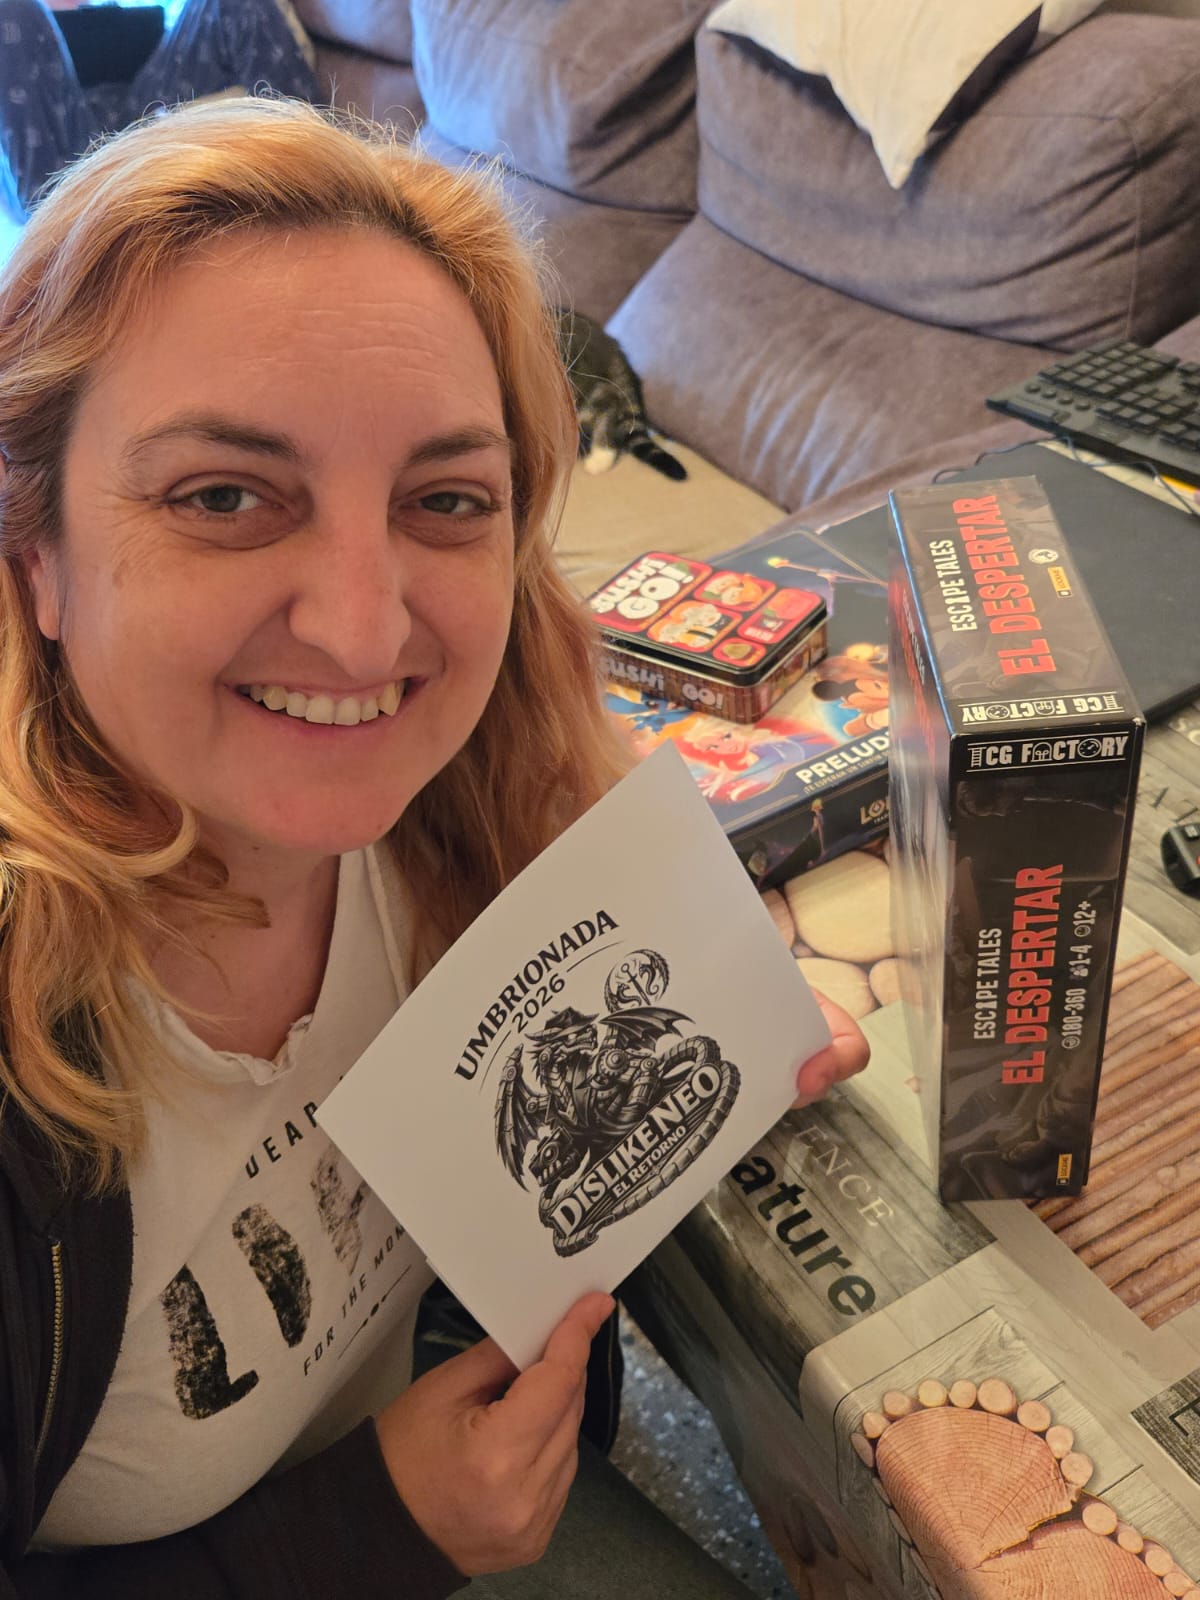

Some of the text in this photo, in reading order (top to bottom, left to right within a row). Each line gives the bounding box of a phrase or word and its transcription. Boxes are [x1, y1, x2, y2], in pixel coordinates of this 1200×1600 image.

[617, 565, 694, 619] GO!
[929, 538, 978, 632] ESCAPE TALES
[953, 495, 1057, 677] EL DESPERTAR
[682, 682, 724, 709] GO!
[962, 694, 1123, 723] TCG FACTORY
[795, 730, 890, 784] PRELUD
[968, 735, 1128, 768] TCG FACTORY
[454, 909, 620, 1082] UMBRIONADA
[512, 973, 567, 1034] 2026
[974, 927, 1002, 1040] ESCAPE TALES
[1002, 864, 1064, 1084] EL DESPERTAR
[1062, 900, 1097, 1036] 180-360 1-4 12+
[612, 1125, 687, 1199] EL RETORNO
[790, 1122, 895, 1228] ENCE
[303, 1325, 335, 1377] FOR
[341, 1273, 368, 1319] THE
